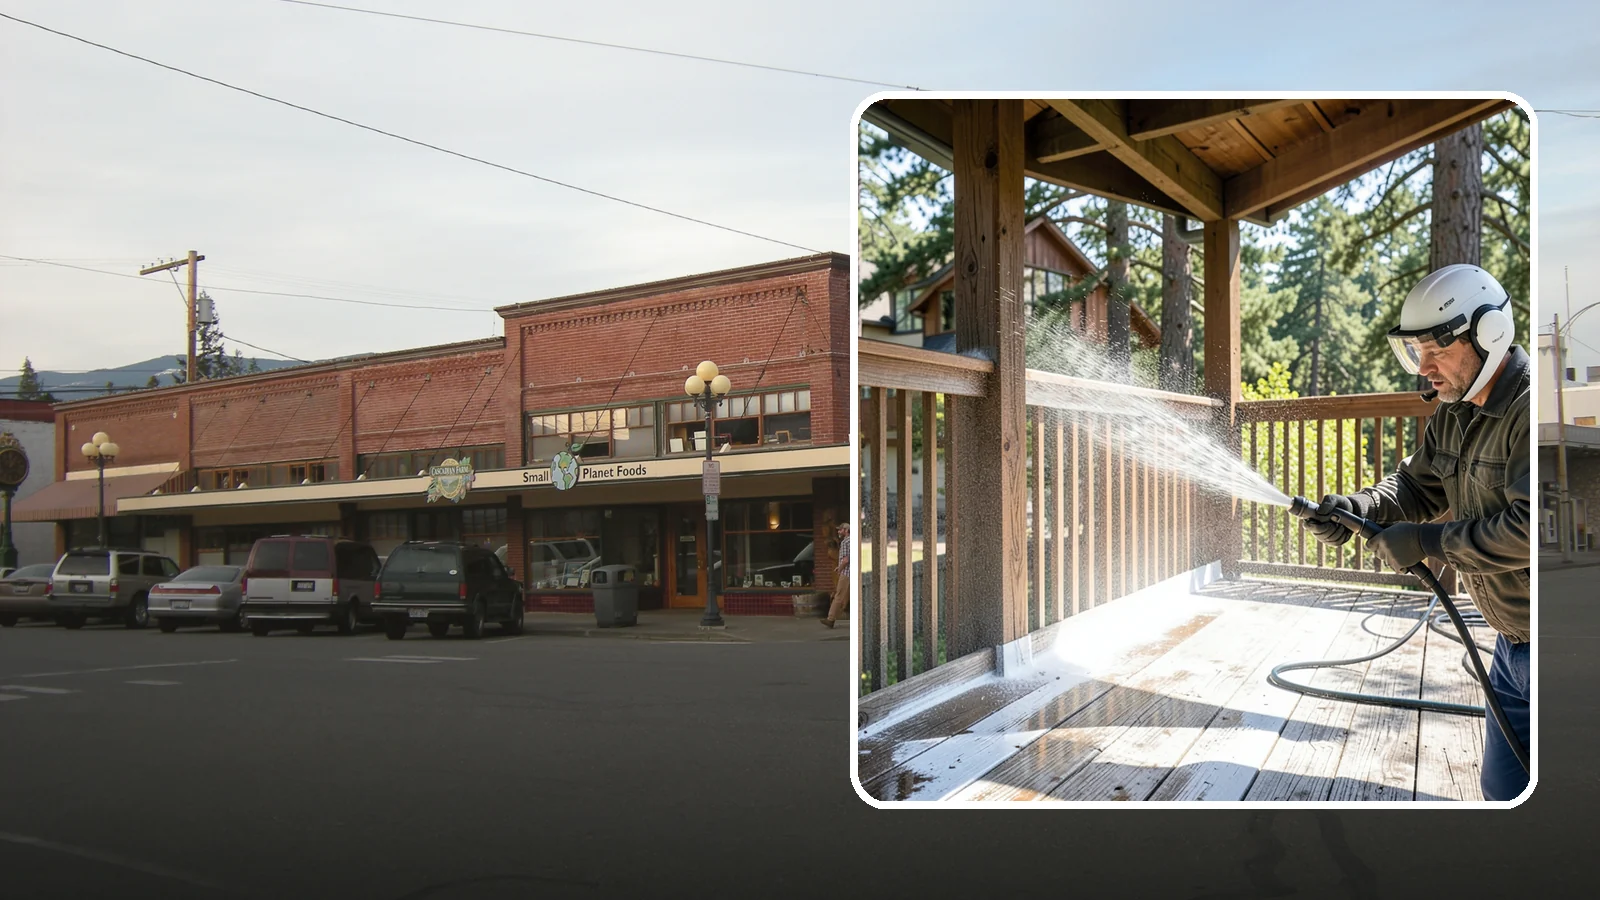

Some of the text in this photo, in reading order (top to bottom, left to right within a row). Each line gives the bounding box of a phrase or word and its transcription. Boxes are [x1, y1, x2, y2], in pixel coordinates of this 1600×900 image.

[523, 464, 647, 483] Small Planet Foods
